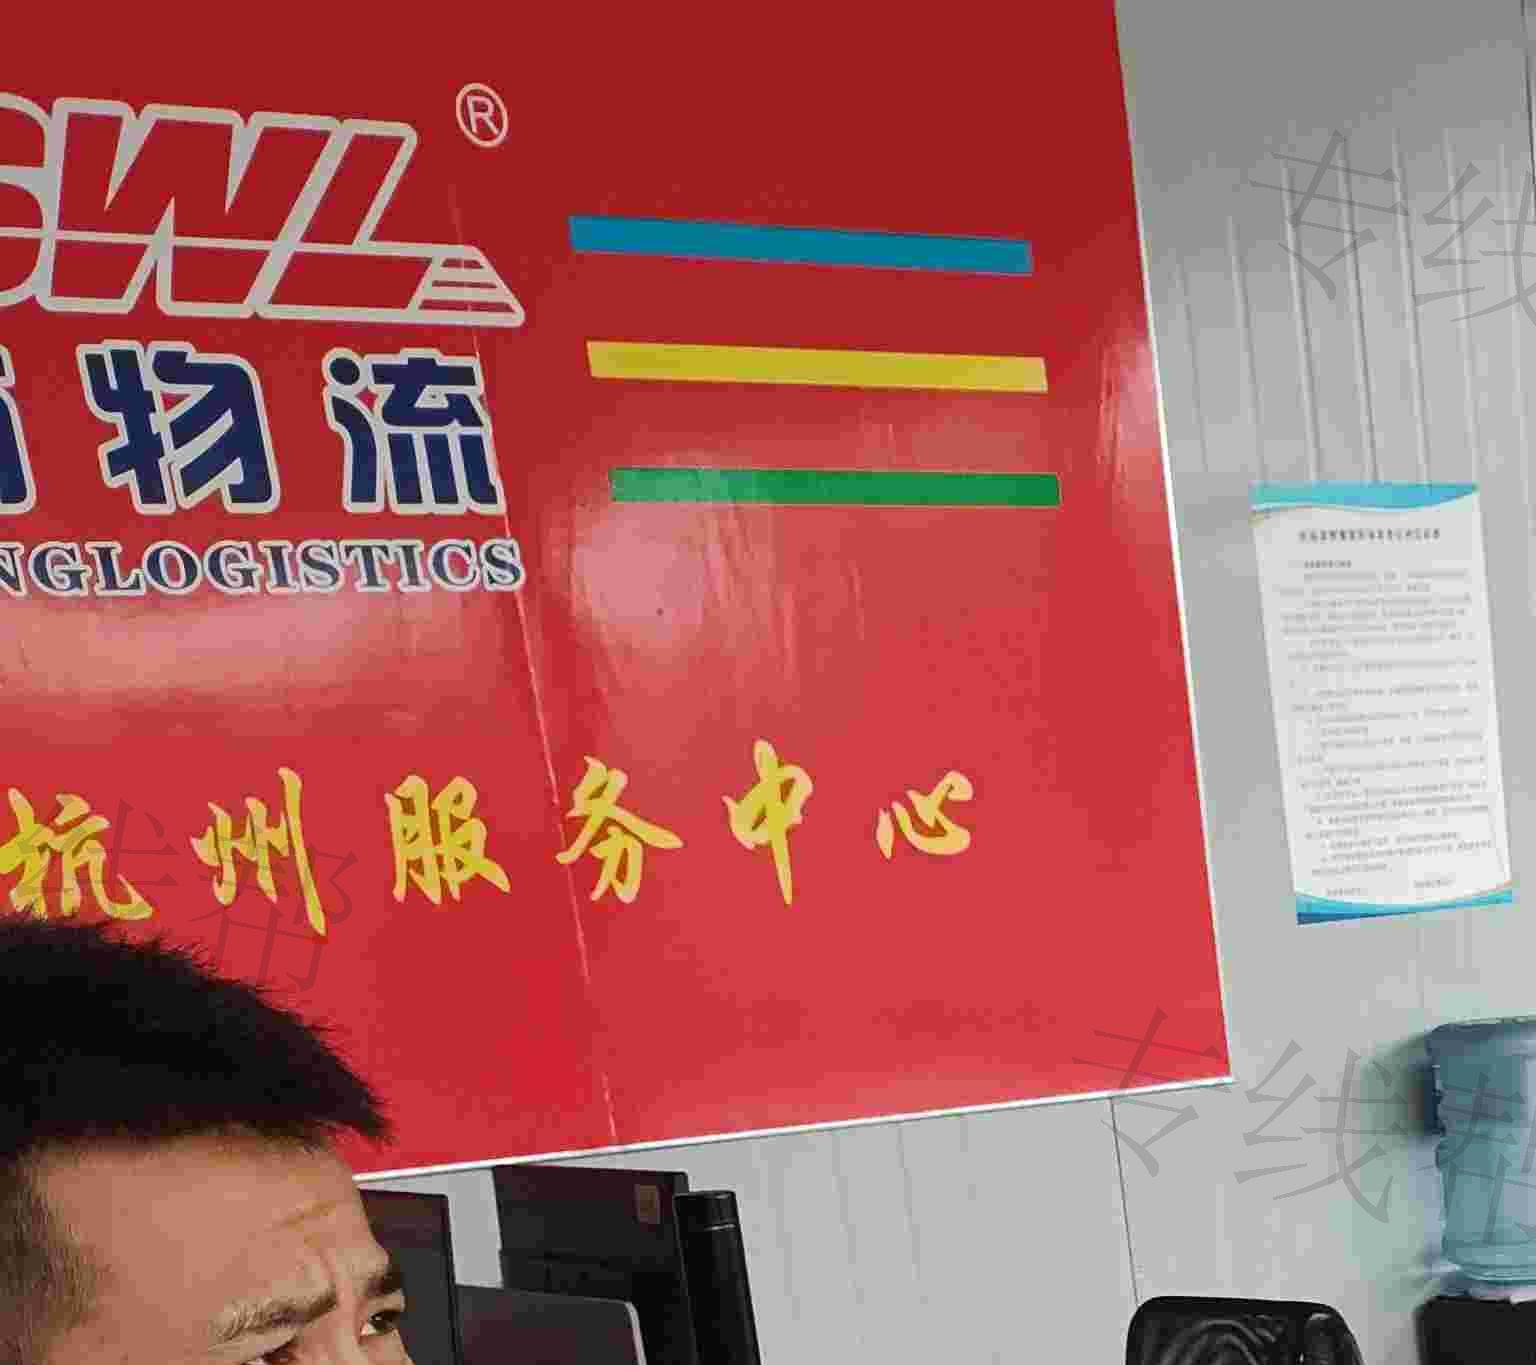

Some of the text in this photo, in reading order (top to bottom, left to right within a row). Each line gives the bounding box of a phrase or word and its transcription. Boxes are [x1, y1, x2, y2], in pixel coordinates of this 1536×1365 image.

[0, 340, 507, 515] 物流
[0, 740, 973, 935] 杭州服务中心
